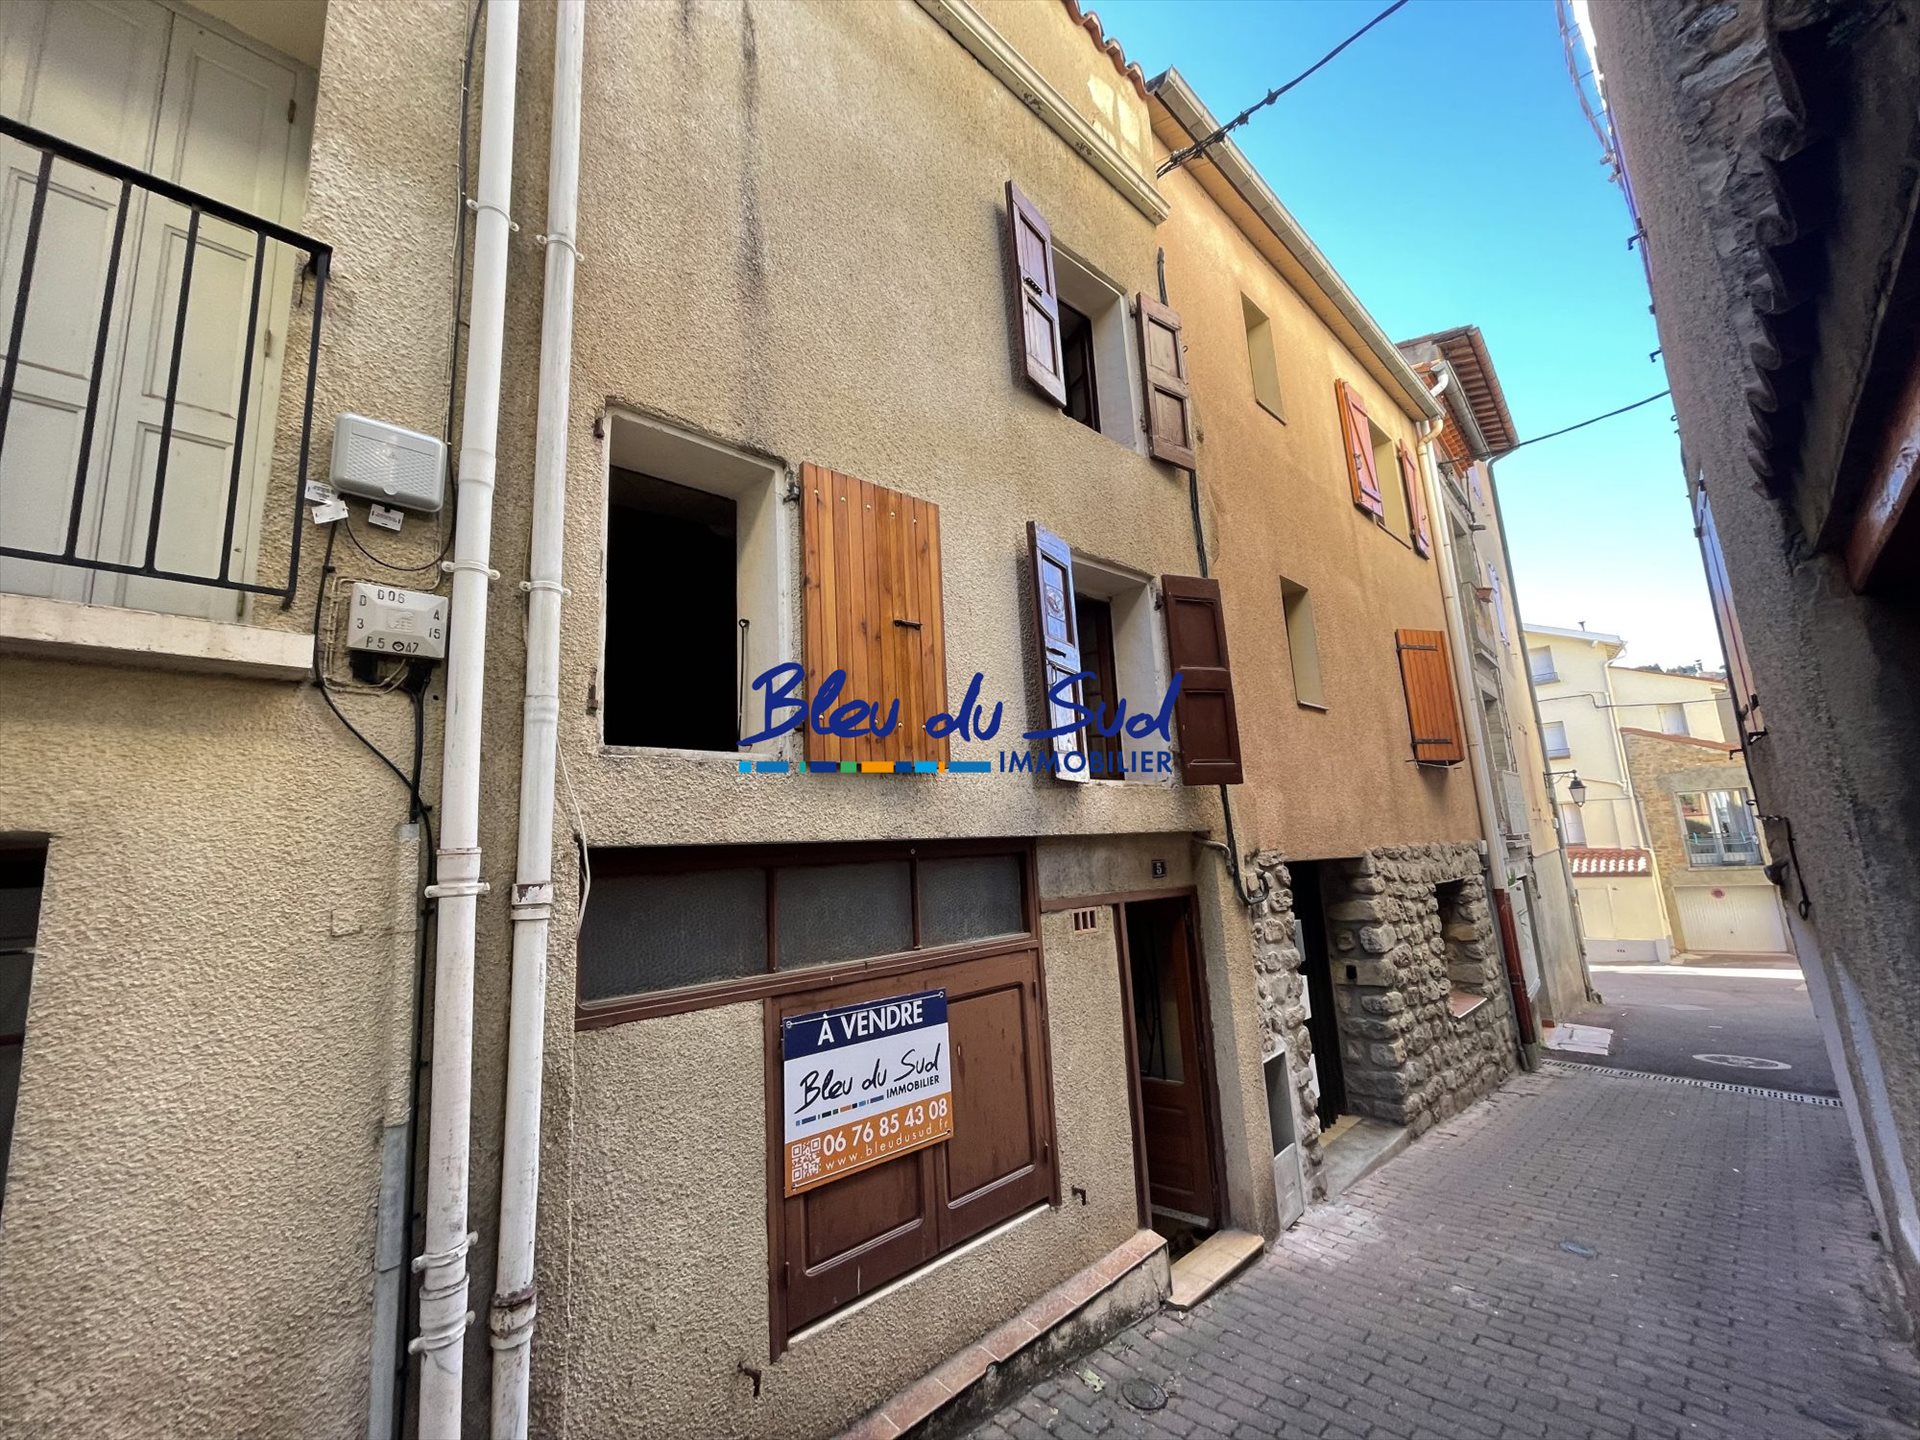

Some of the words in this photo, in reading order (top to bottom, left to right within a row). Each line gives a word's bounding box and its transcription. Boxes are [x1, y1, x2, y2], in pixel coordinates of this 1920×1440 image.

[356, 618, 364, 629] 3
[1156, 862, 1162, 875] 5
[817, 1013, 835, 1046] À
[841, 1000, 923, 1040] VENDRE
[794, 1069, 853, 1114] Bleu
[861, 1058, 887, 1090] du
[894, 1043, 941, 1082] Sud
[886, 1075, 940, 1099] IMMOBILIER
[823, 1131, 847, 1156] 06
[852, 1121, 874, 1147] 76
[880, 1113, 900, 1137] 85
[904, 1105, 924, 1127] 43
[928, 1097, 948, 1120] 08
[825, 1118, 949, 1171] www.bleudusud.fr
